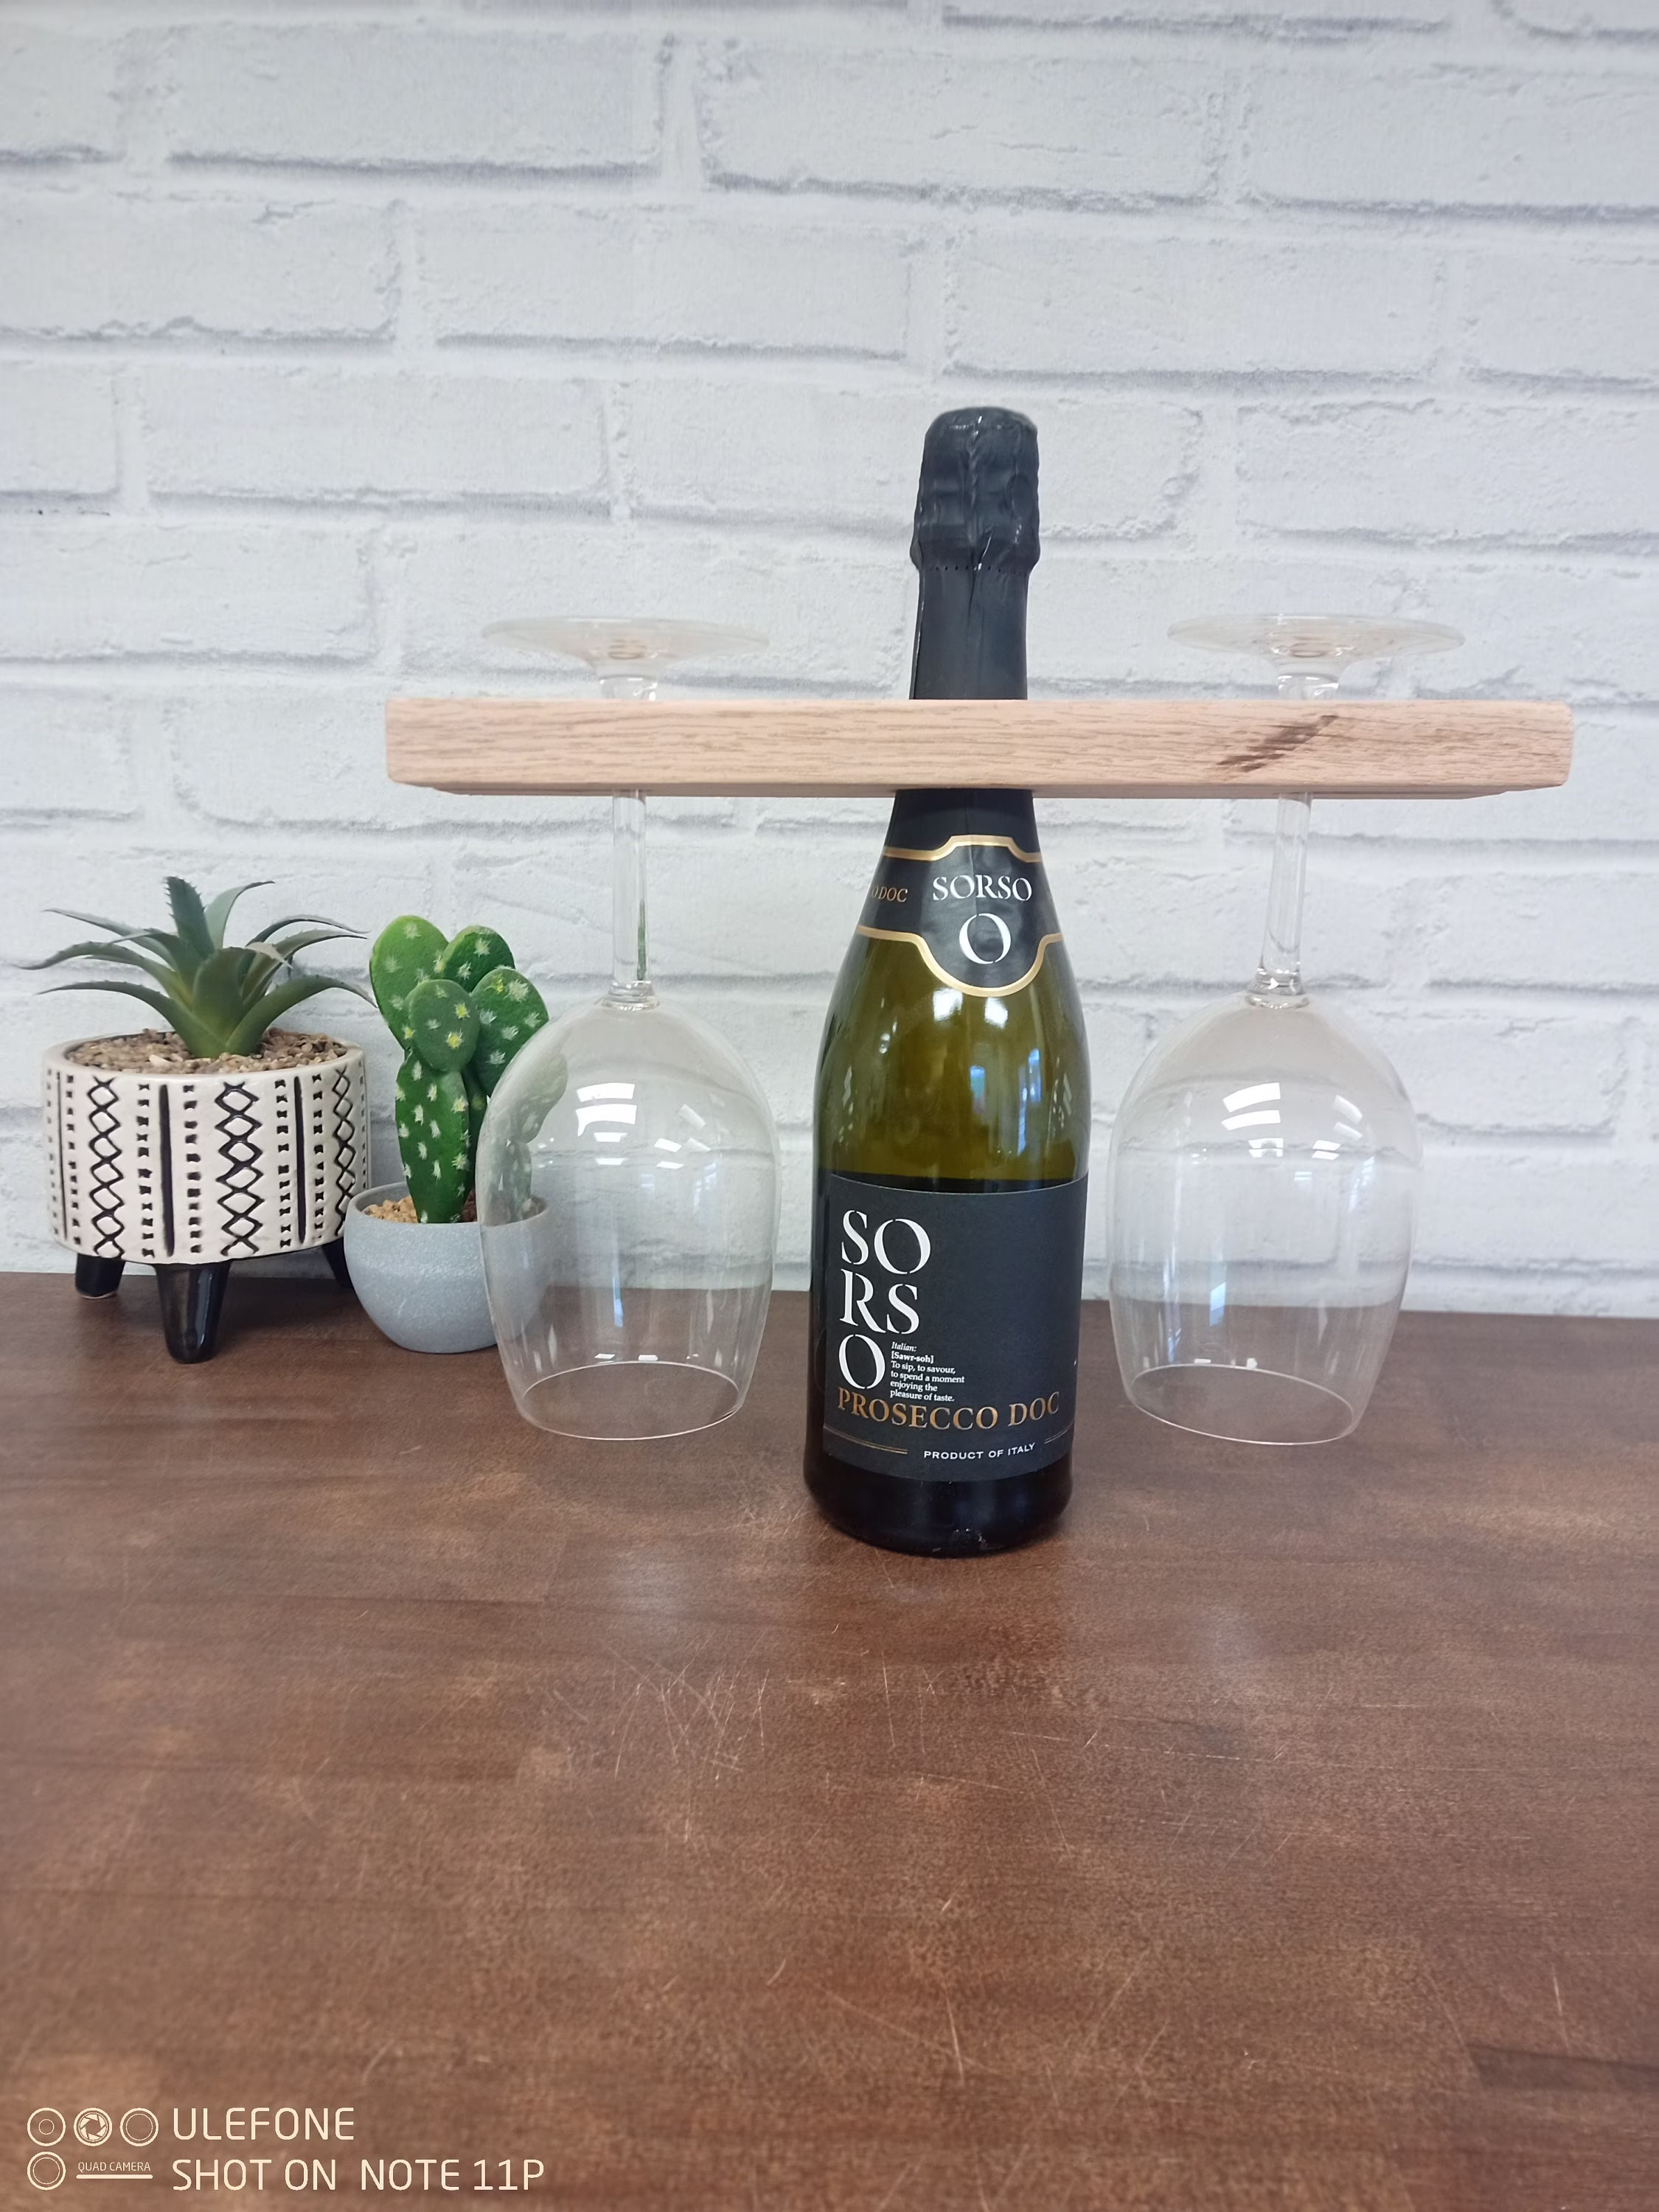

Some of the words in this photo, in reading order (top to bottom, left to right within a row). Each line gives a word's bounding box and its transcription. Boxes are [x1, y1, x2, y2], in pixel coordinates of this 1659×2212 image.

[878, 886, 908, 902] DOC
[932, 874, 1033, 902] SORSO
[959, 913, 1012, 964] O
[841, 1210, 931, 1275] SO
[840, 1268, 920, 1335] RS
[891, 1341, 917, 1352] Italian:
[838, 1334, 886, 1390] O
[891, 1350, 934, 1364] [Sawr-soh]
[891, 1360, 900, 1369] To
[901, 1362, 916, 1372] sip,
[927, 1366, 956, 1374] savour,
[891, 1370, 899, 1378] to
[900, 1372, 923, 1382] spend
[890, 1380, 923, 1392] enjoying
[925, 1383, 938, 1391] the
[890, 1390, 922, 1399] pleasure
[923, 1393, 933, 1401] of
[933, 1394, 955, 1402] taste.
[838, 1386, 998, 1430] PROSECCO
[1008, 1391, 1060, 1427] DOC
[924, 1450, 984, 1460] PRODUCT
[989, 1449, 1004, 1458] OF
[1007, 1442, 1036, 1456] ITALY
